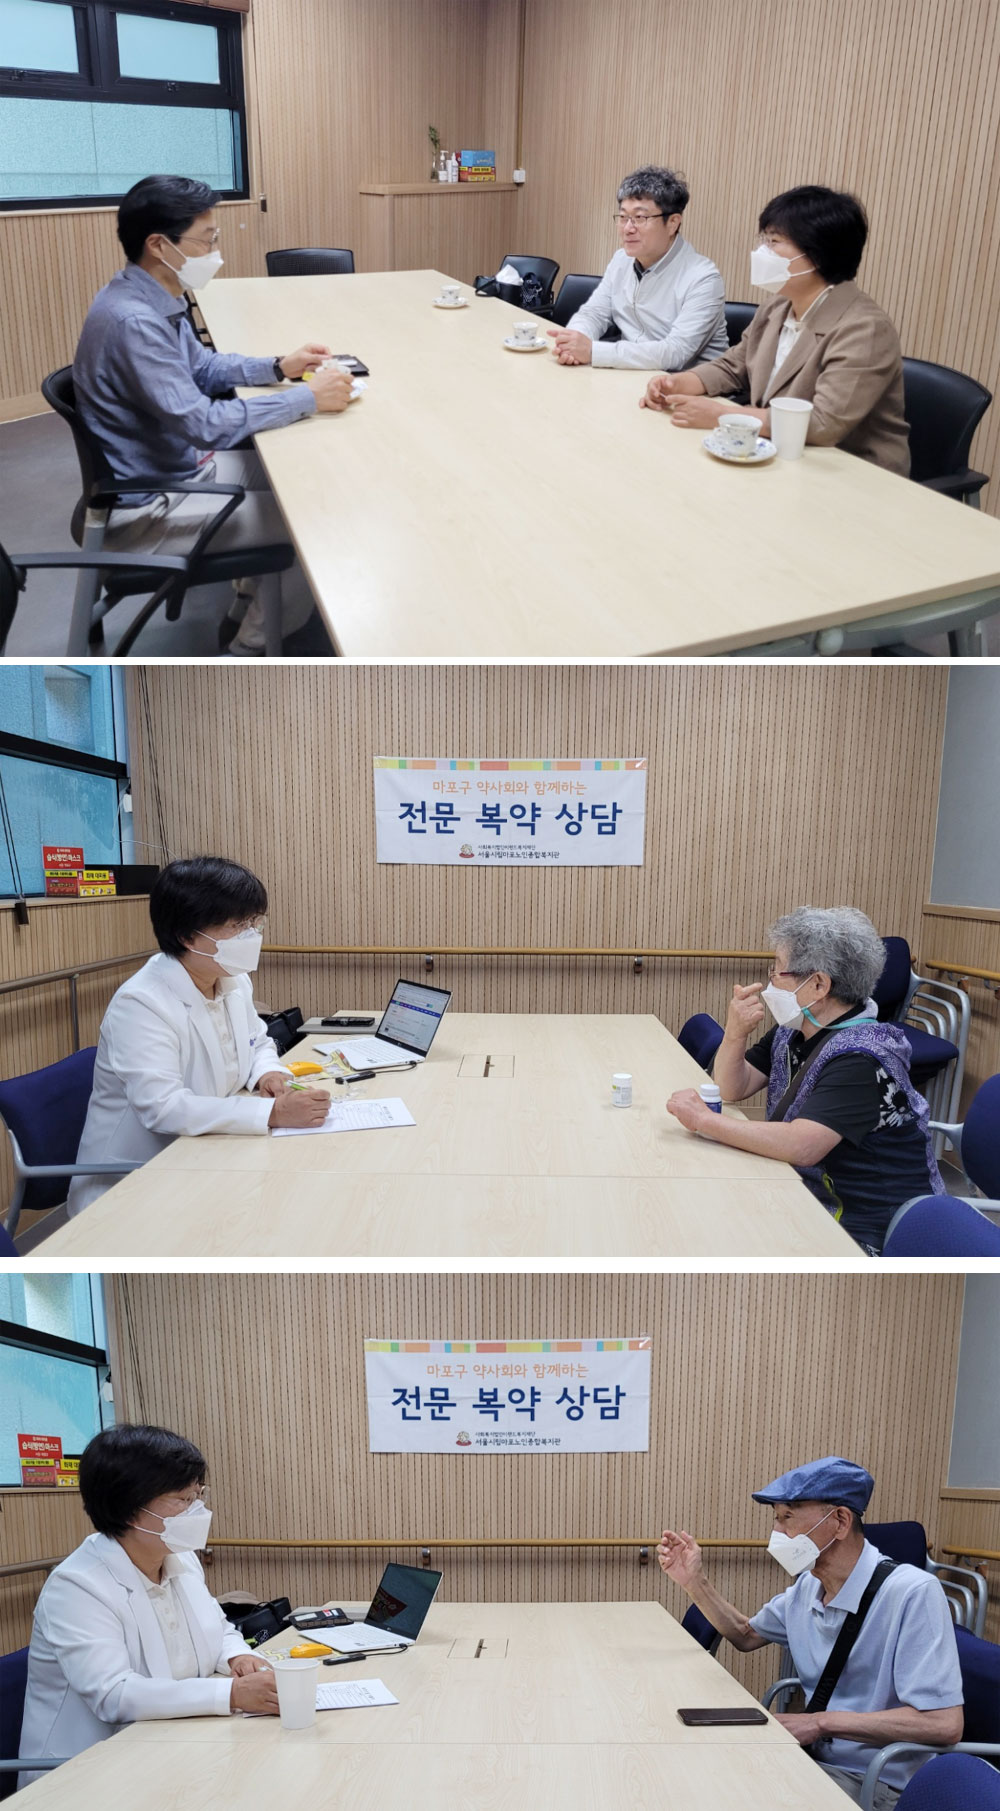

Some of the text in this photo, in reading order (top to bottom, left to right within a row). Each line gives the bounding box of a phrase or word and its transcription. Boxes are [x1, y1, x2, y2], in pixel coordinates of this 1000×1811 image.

[432, 779, 588, 796] 마포구 약사회와 함께하는
[398, 801, 623, 836] 전문 복약 상담
[477, 850, 561, 859] 서울시립마포노인종합복지관
[426, 1363, 589, 1379] 마포구 약사회와 함께하는
[391, 1385, 627, 1422] 전문 복약 상담
[475, 1438, 562, 1447] 서울시립마포노인종합복지관
